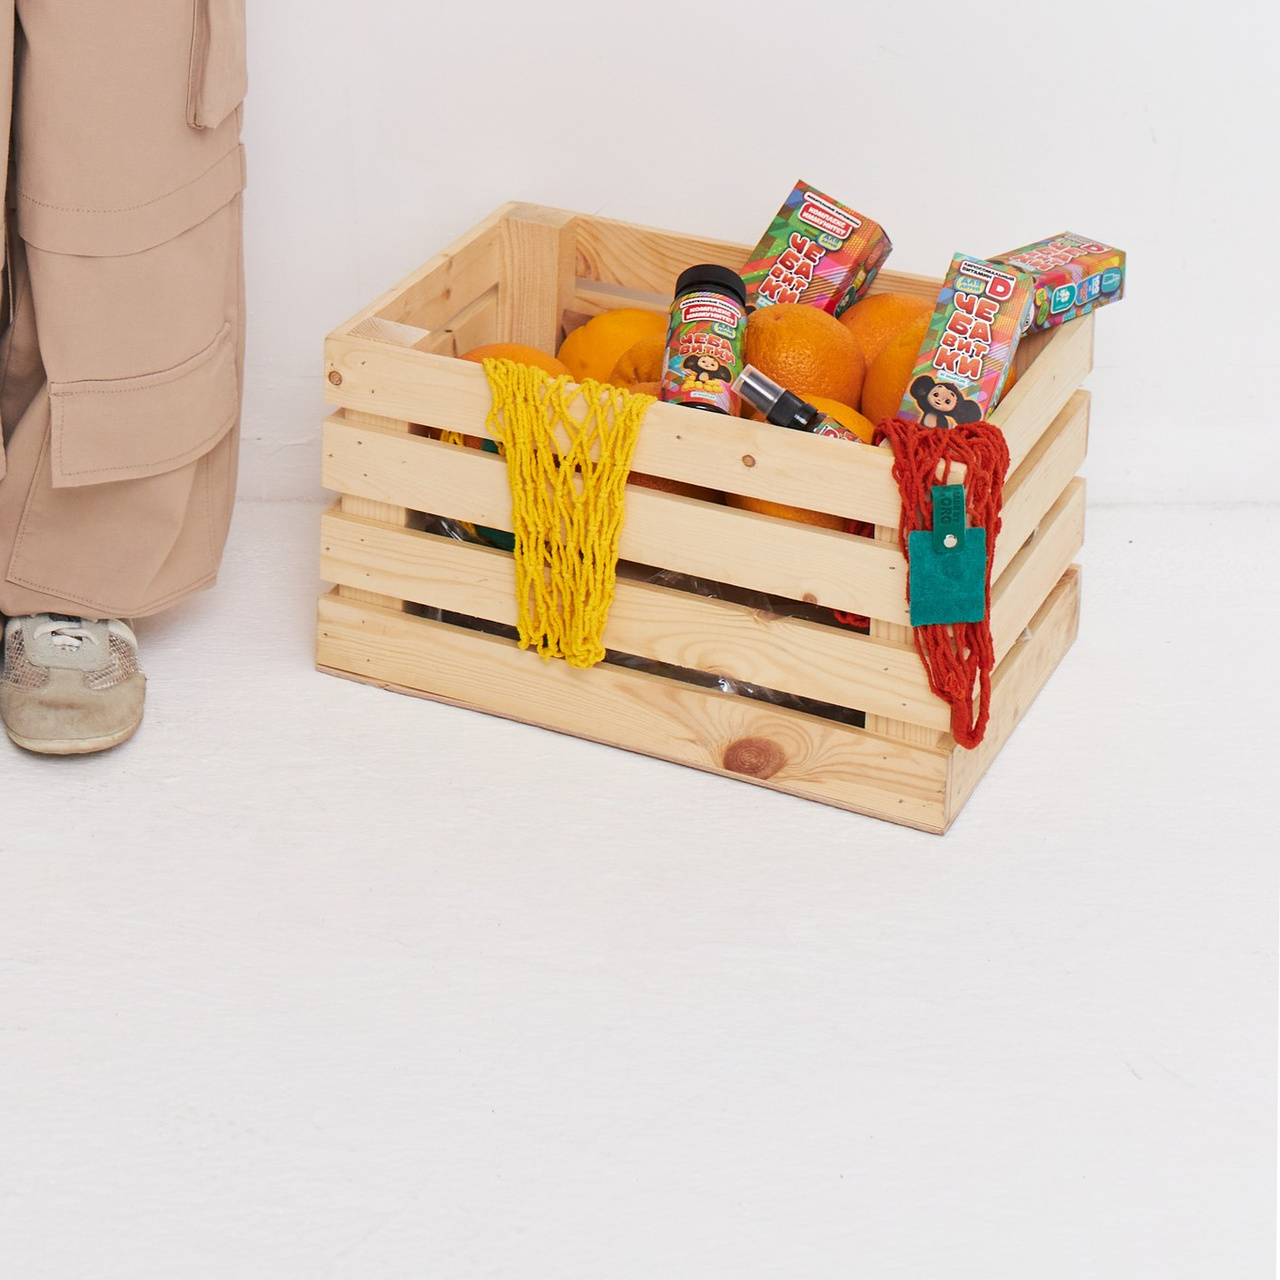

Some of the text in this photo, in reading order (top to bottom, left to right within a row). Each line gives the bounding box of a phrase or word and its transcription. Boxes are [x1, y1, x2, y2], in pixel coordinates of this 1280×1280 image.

[789, 232, 826, 264] ЧЕ
[769, 264, 809, 292] ВИТ
[777, 248, 814, 282] БА
[758, 276, 800, 304] КИ
[962, 267, 1011, 299] ВИТАМИН D
[954, 292, 1000, 323] ЧЕ
[946, 310, 992, 344] БА
[679, 344, 736, 365] ВИТКИ
[680, 333, 732, 353] ЧЕБА
[940, 331, 989, 358] ВИТ
[933, 346, 982, 380] КИ
